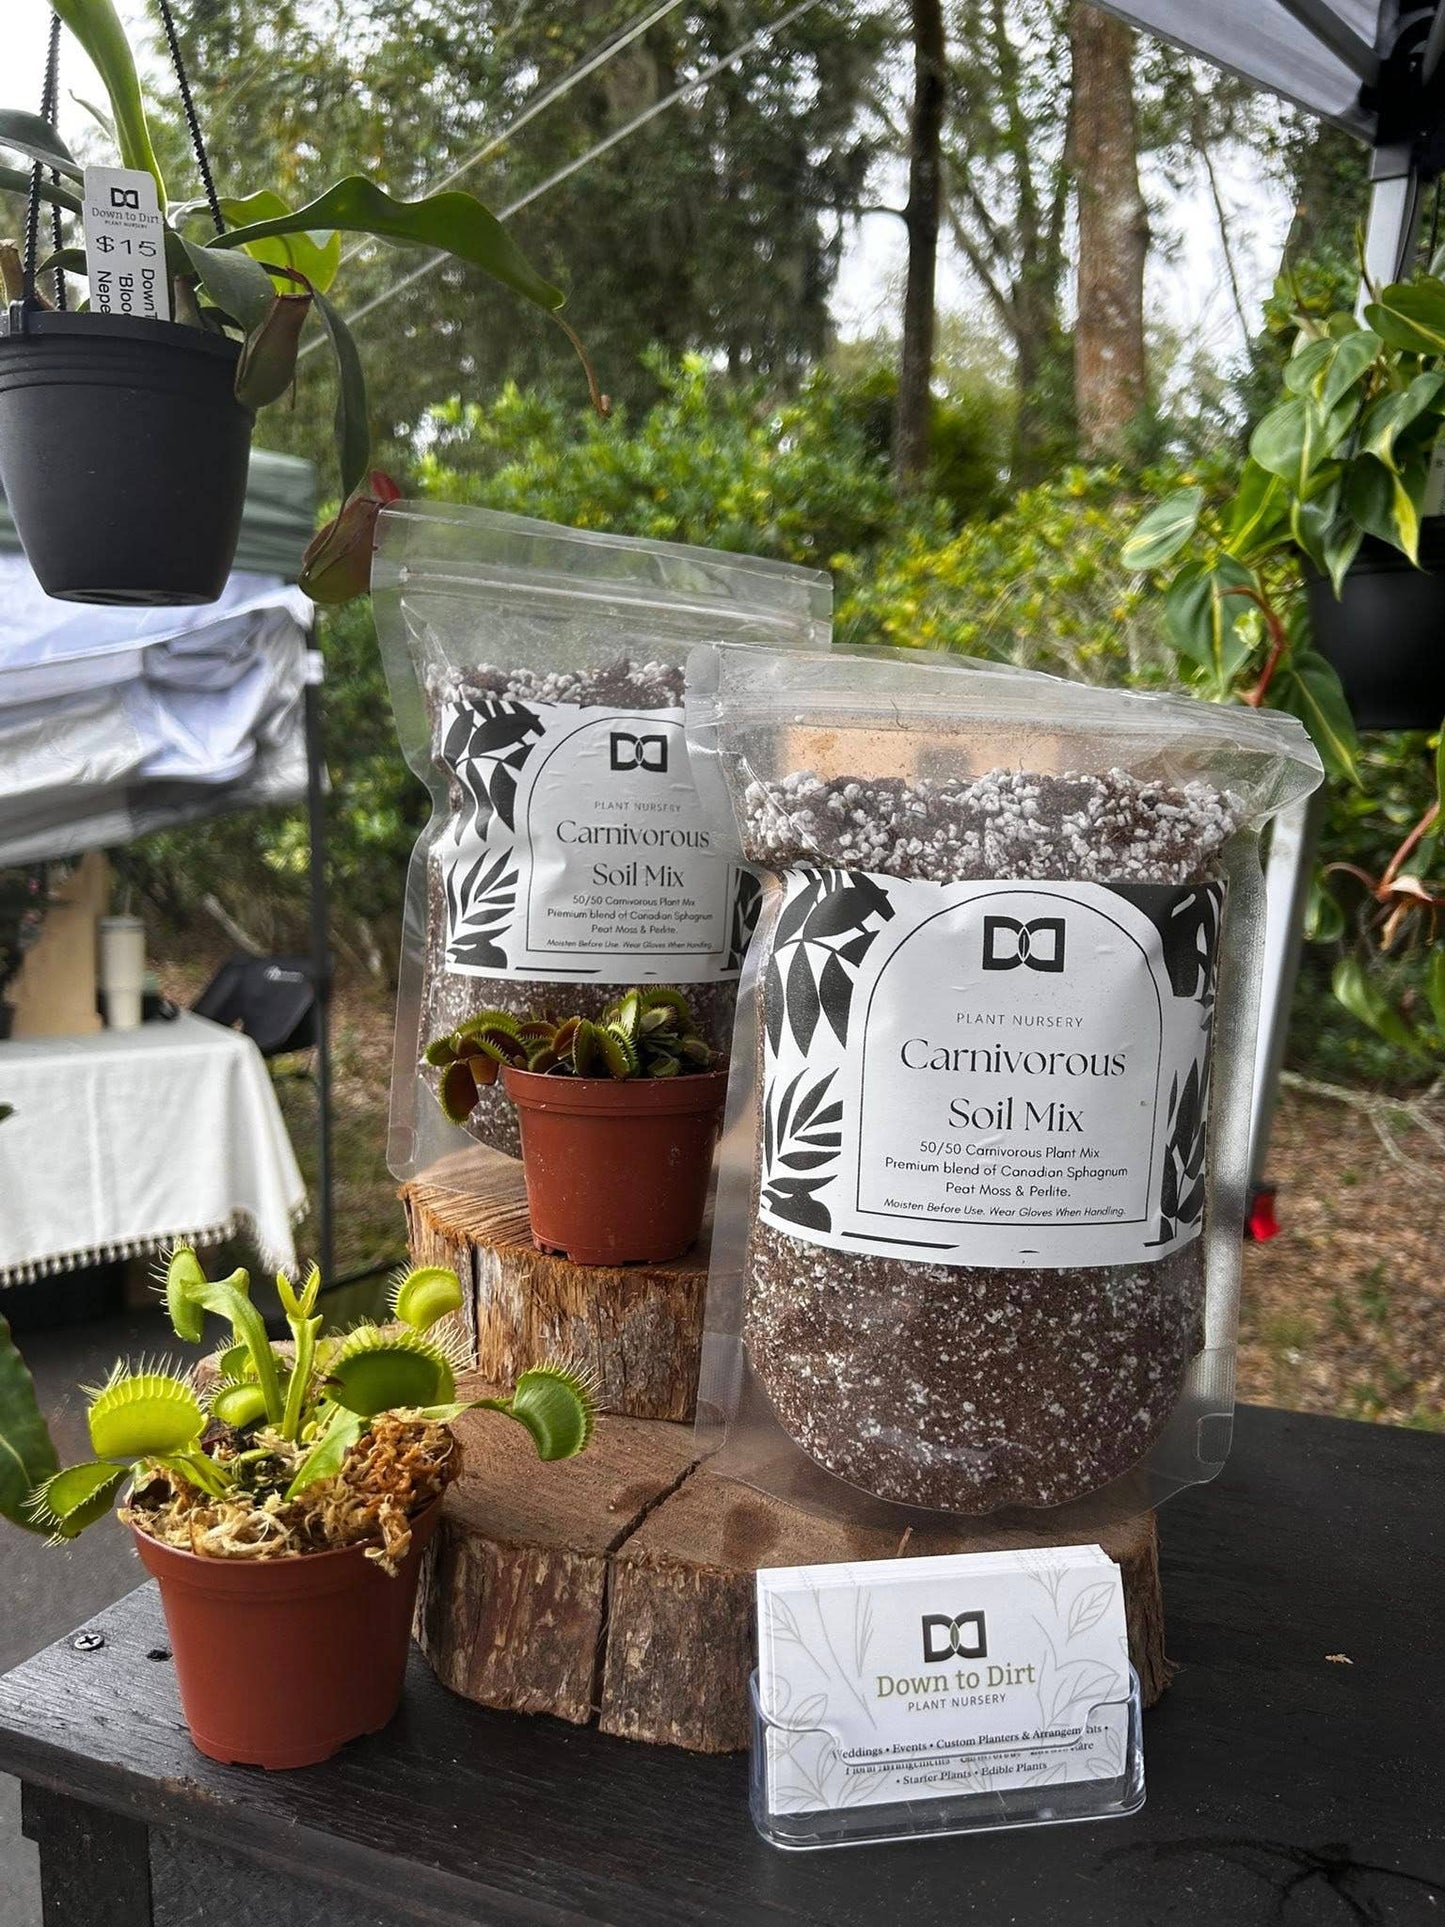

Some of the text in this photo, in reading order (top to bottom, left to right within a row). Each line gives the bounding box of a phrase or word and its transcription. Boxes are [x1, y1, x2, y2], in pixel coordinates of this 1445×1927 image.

[92, 207, 159, 224] Down to Dirt
[96, 235, 157, 257] $15
[594, 800, 682, 813] PLANT NURSERY
[556, 820, 710, 849] Carnivorous
[592, 862, 685, 888] Soil Mix
[573, 895, 695, 906] 50/50 Carnivorous Plant Mix
[547, 908, 713, 922] Premium blend of Canadian Sphagnum
[592, 924, 613, 934] Peat
[615, 925, 638, 934] Moss
[640, 926, 646, 934] &
[547, 939, 577, 947] Moisten
[956, 1012, 1084, 1028] PLANT NURSERY
[901, 1038, 1126, 1077] Carnivorous
[949, 1097, 1084, 1133] Soil Mix
[919, 1141, 1101, 1159] 50/50 Carnivorous Plant Mix
[885, 1157, 1128, 1180] Premium blend of Canadian Sphagnum
[946, 1182, 1072, 1198] Peat Moss & Perlite.
[883, 1198, 1127, 1218] Moisten Before Use. Wear Gloves When Handling.
[877, 1662, 1036, 1698] Down to Dirt
[908, 1693, 1006, 1712] PLANT NURSERY
[893, 1743, 927, 1754] Events
[936, 1738, 976, 1749] Custom
[978, 1732, 1019, 1745] Planters
[1022, 1731, 1030, 1740] &
[903, 1762, 1047, 1785] Starter Plants Edible Plants
